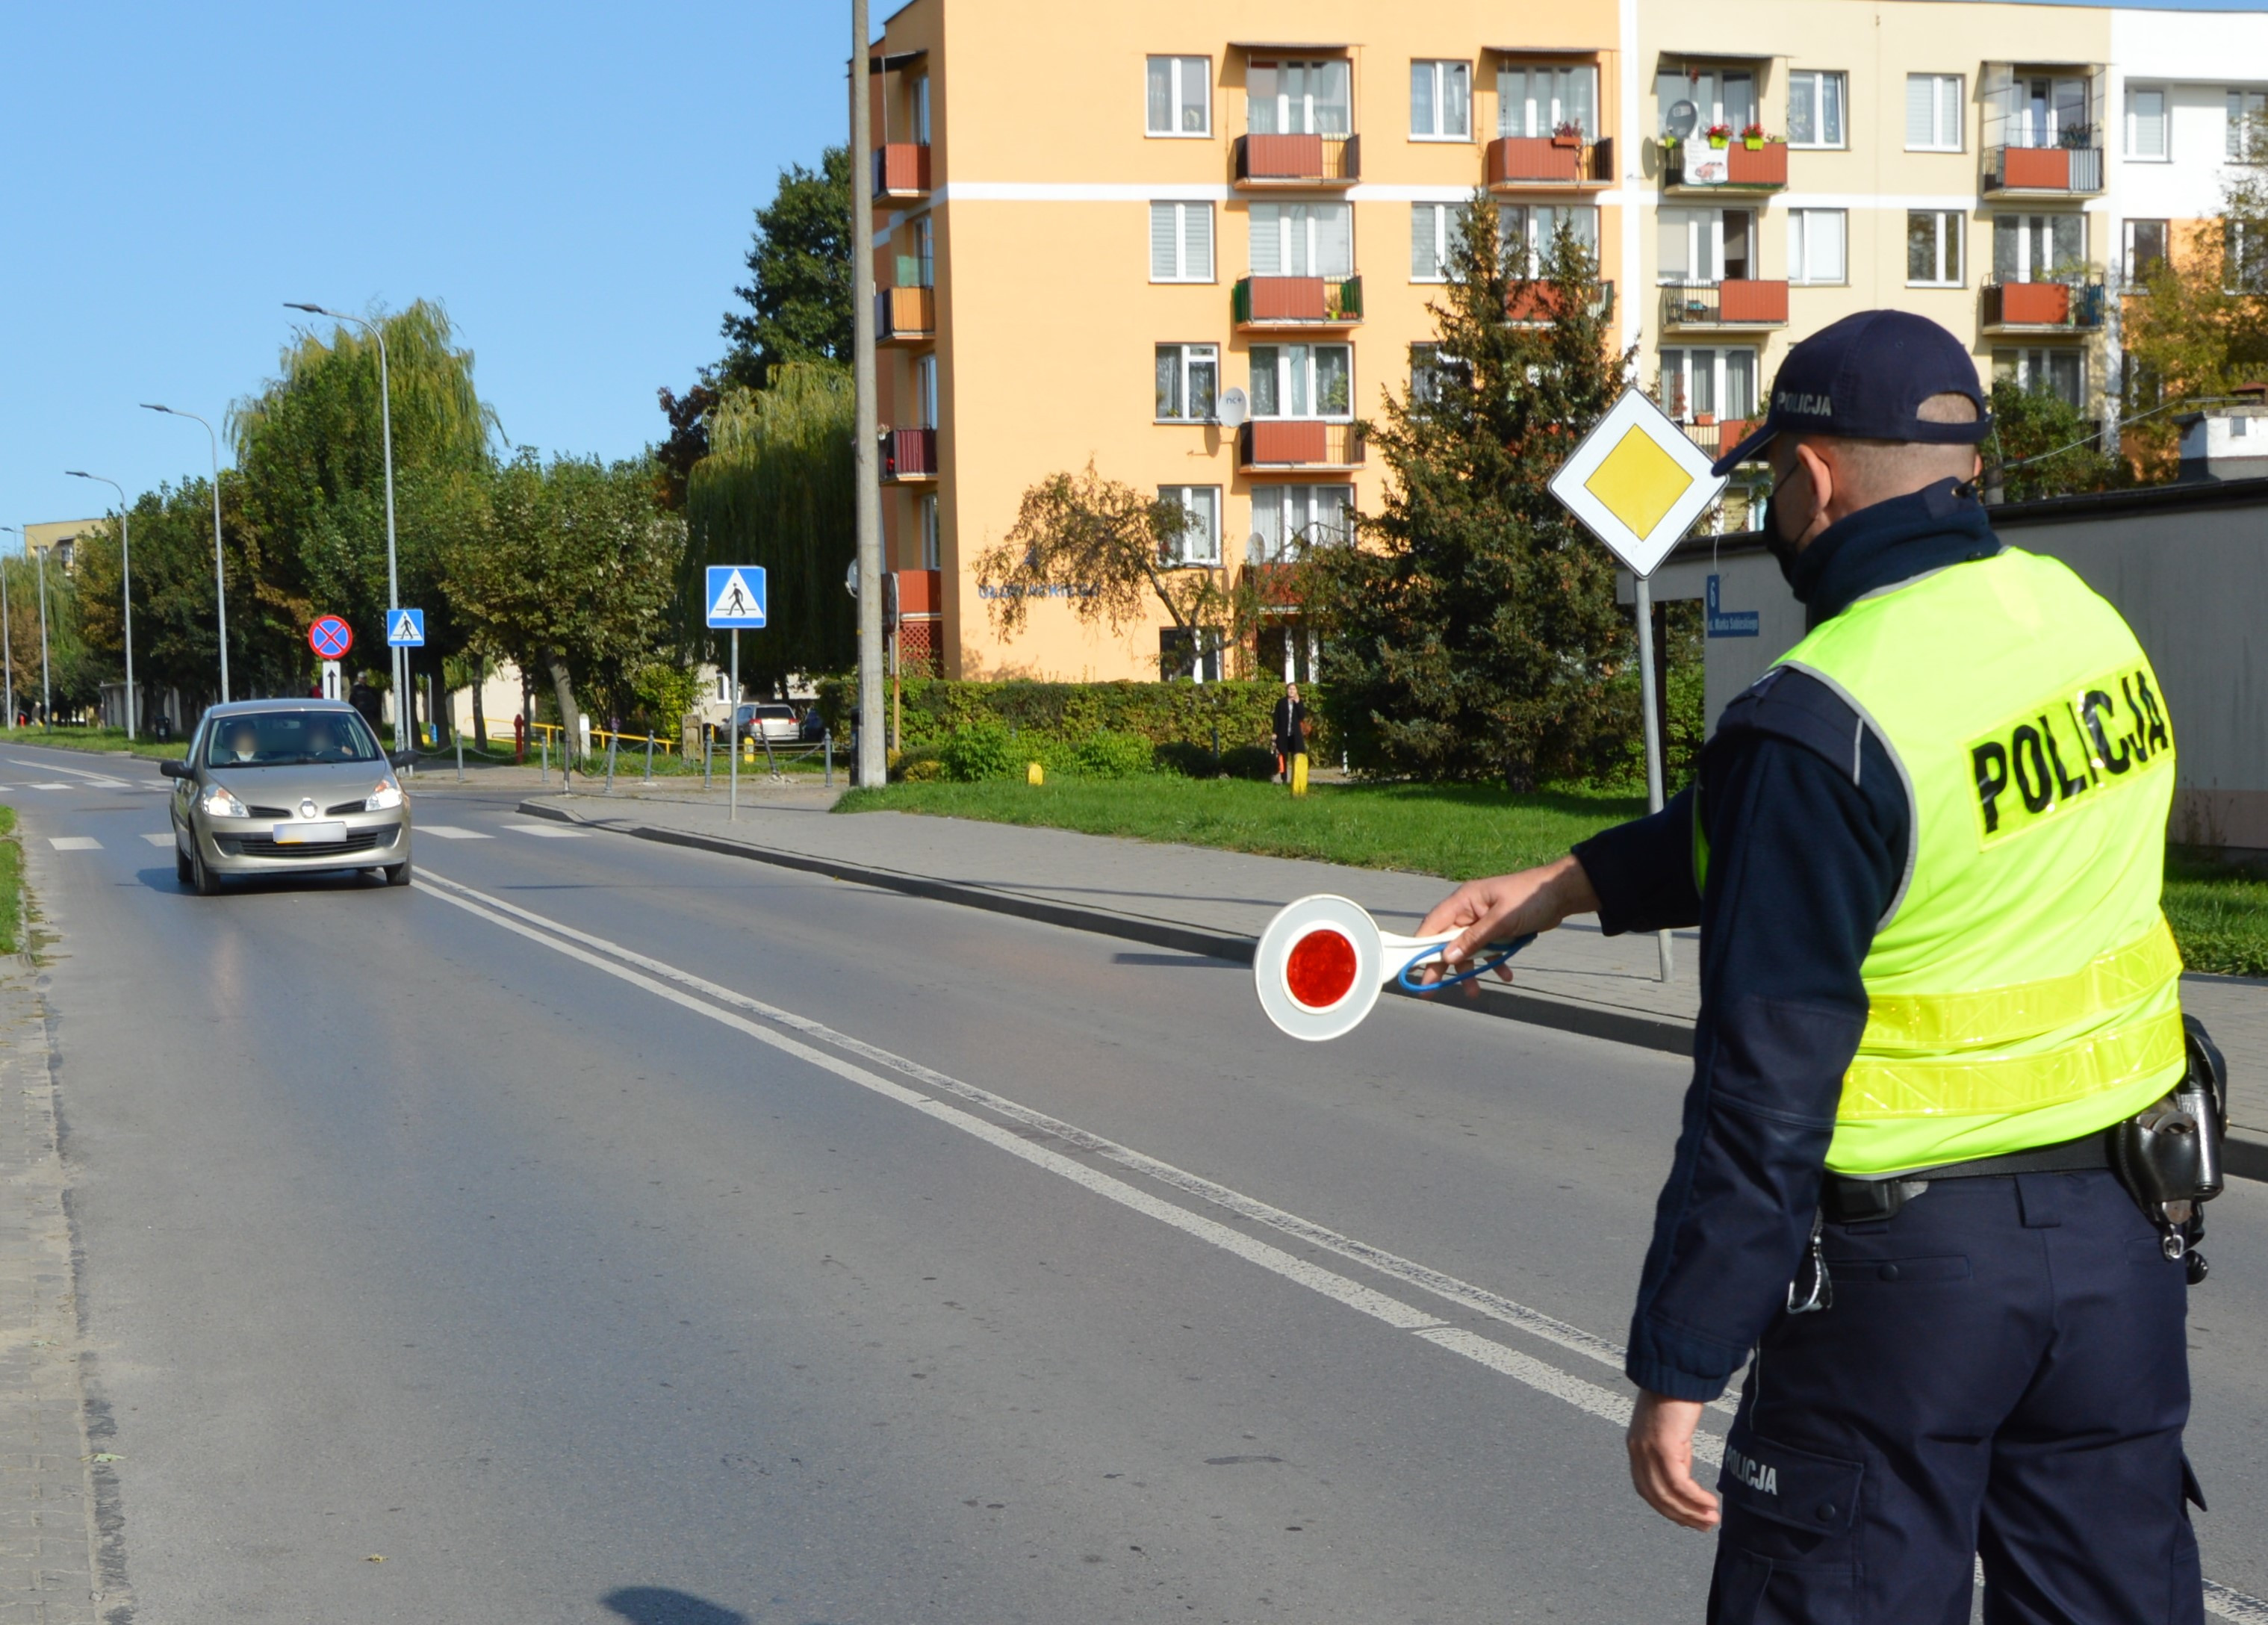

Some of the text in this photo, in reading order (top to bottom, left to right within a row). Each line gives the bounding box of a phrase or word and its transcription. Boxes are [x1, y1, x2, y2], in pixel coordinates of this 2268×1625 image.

[1226, 397, 1242, 405] nc+
[1777, 391, 1832, 417] POLICJA
[1972, 670, 2169, 834] POLICJA
[1725, 1445, 1777, 1496] POLICJA
